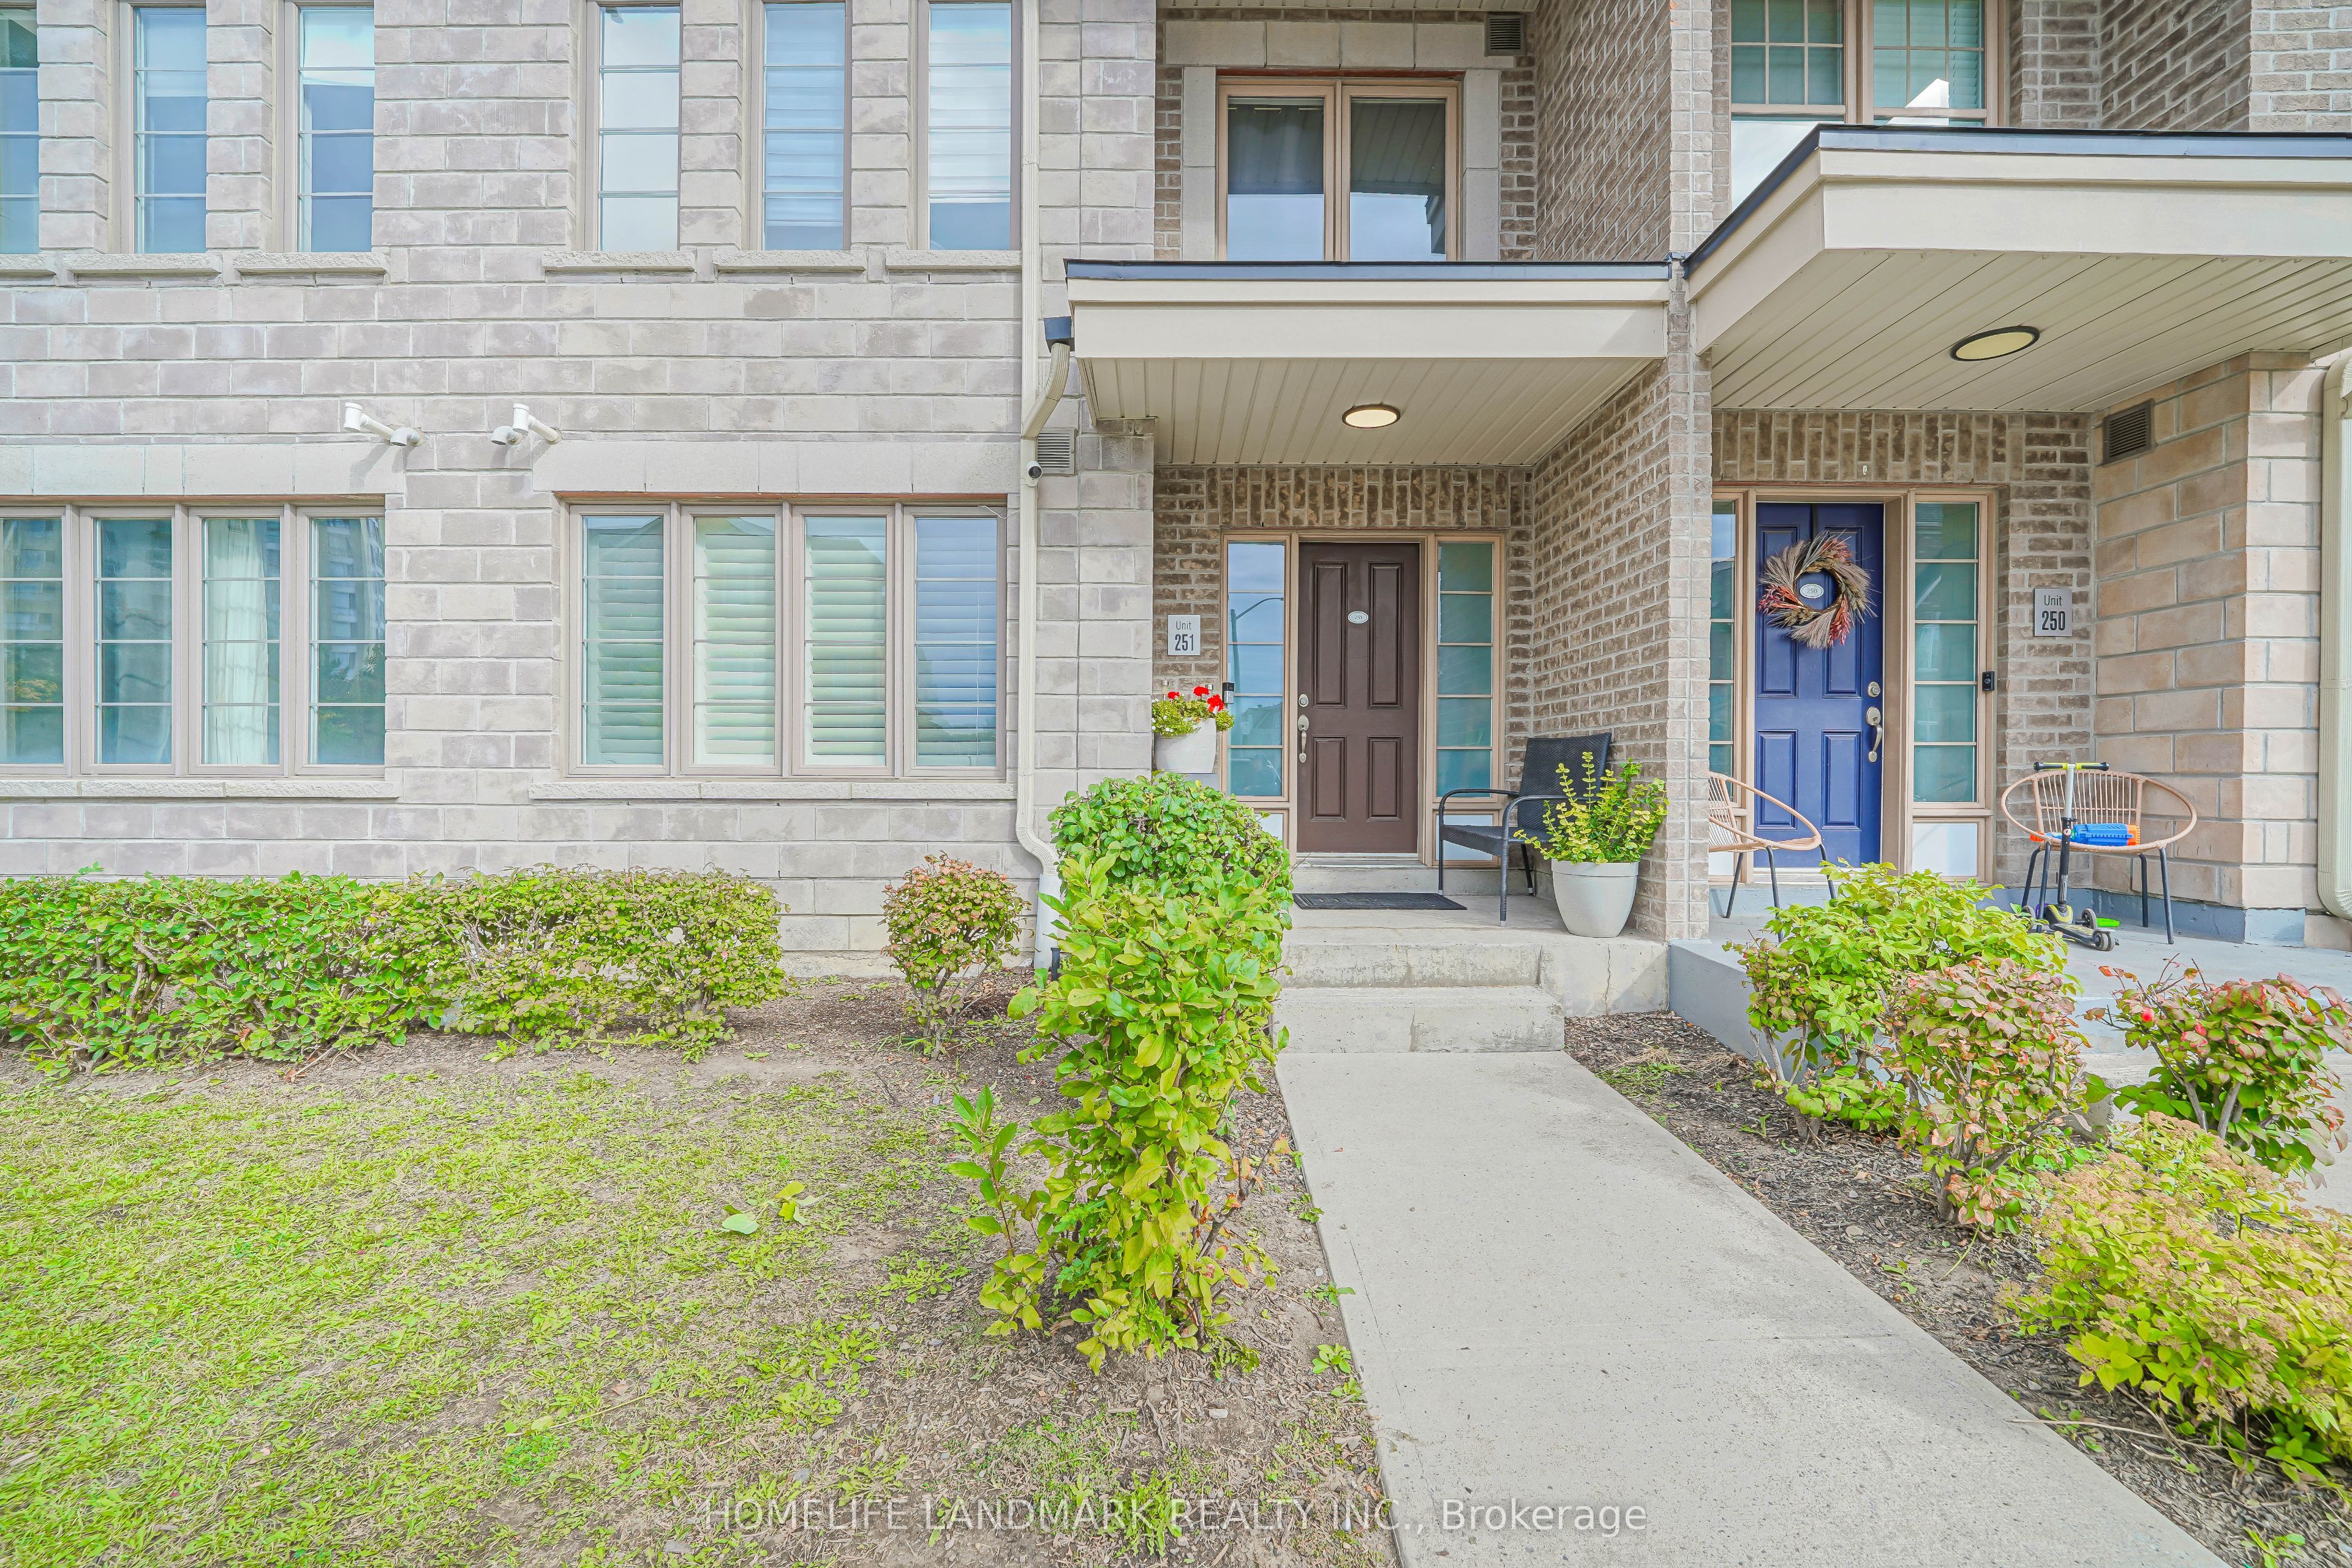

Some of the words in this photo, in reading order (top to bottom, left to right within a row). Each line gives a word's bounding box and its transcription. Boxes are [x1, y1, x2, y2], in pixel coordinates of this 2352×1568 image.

[2044, 595, 2062, 606] Unit
[1175, 620, 1192, 630] Unit
[2041, 610, 2066, 631] 250
[1175, 634, 1194, 651] 251
